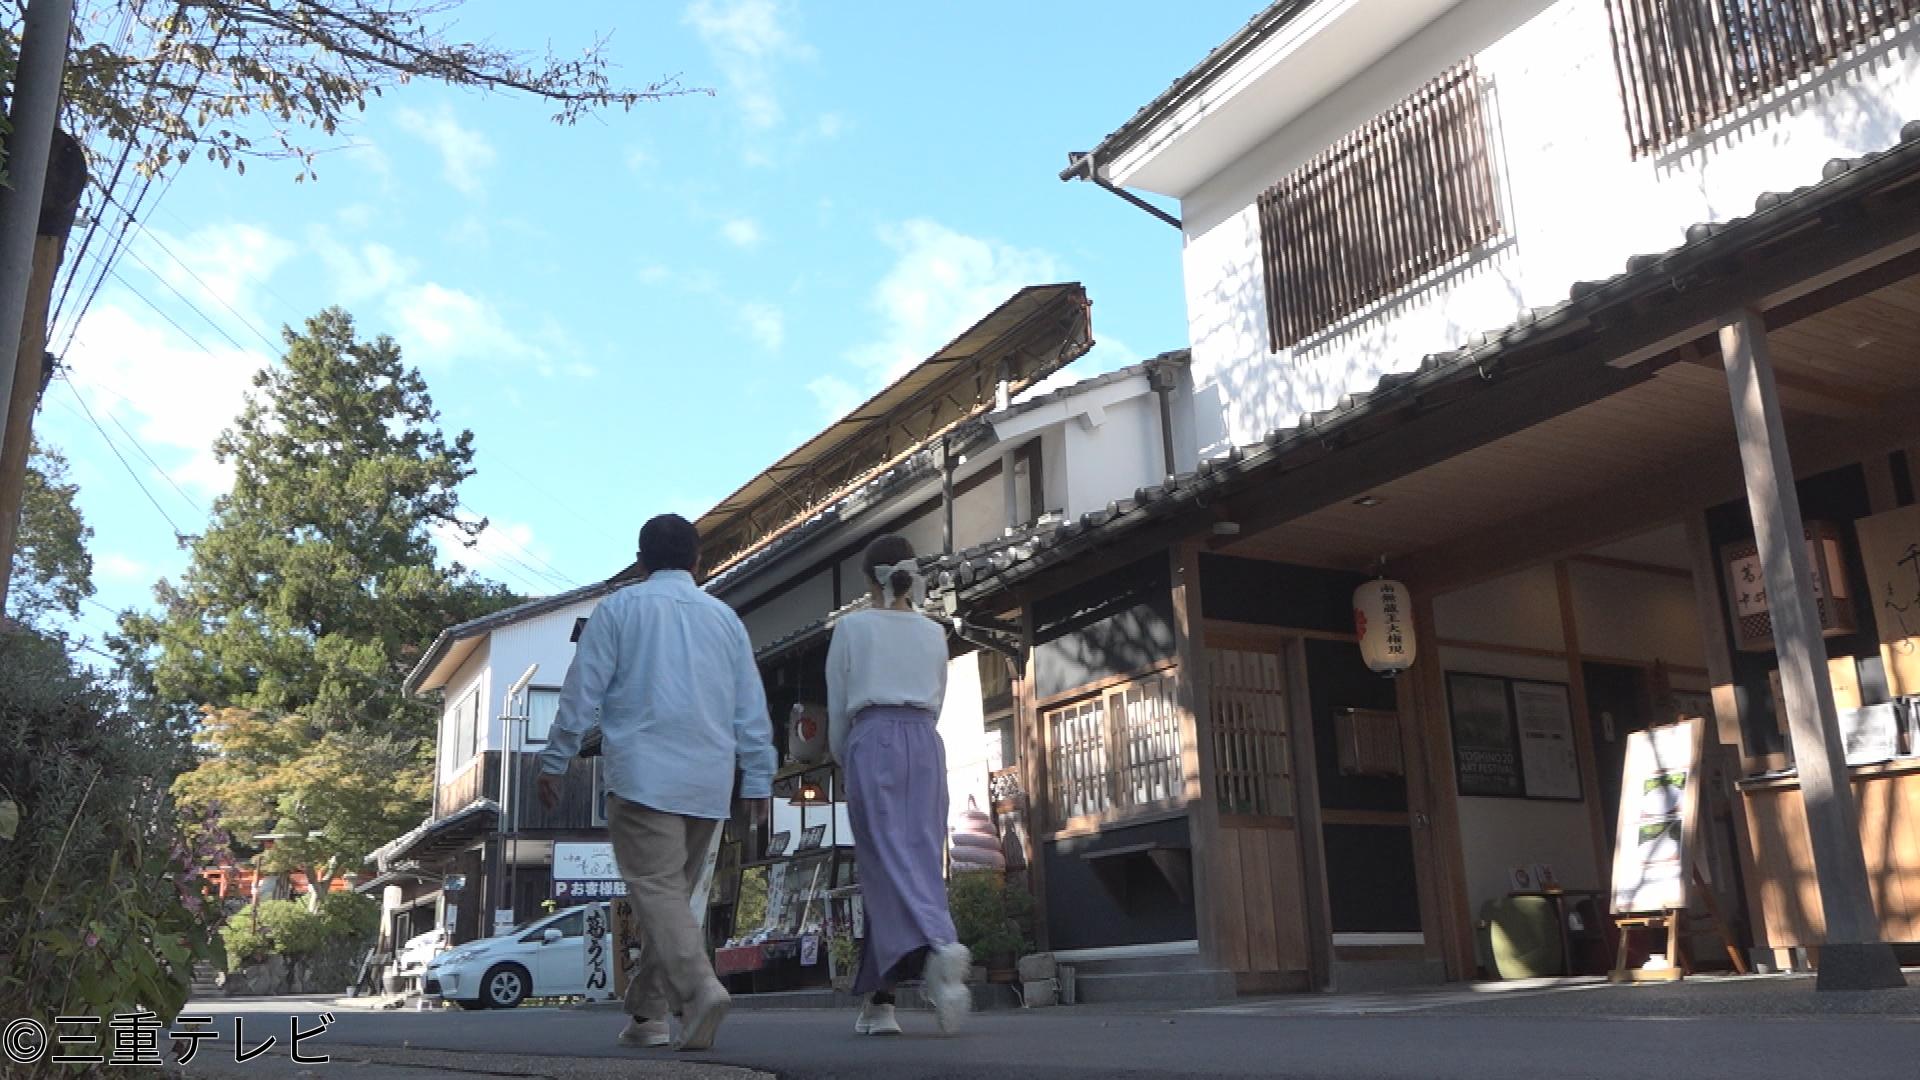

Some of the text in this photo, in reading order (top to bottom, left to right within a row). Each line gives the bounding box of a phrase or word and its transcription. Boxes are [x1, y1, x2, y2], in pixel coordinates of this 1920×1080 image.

[555, 881, 630, 897] P お客様駐
